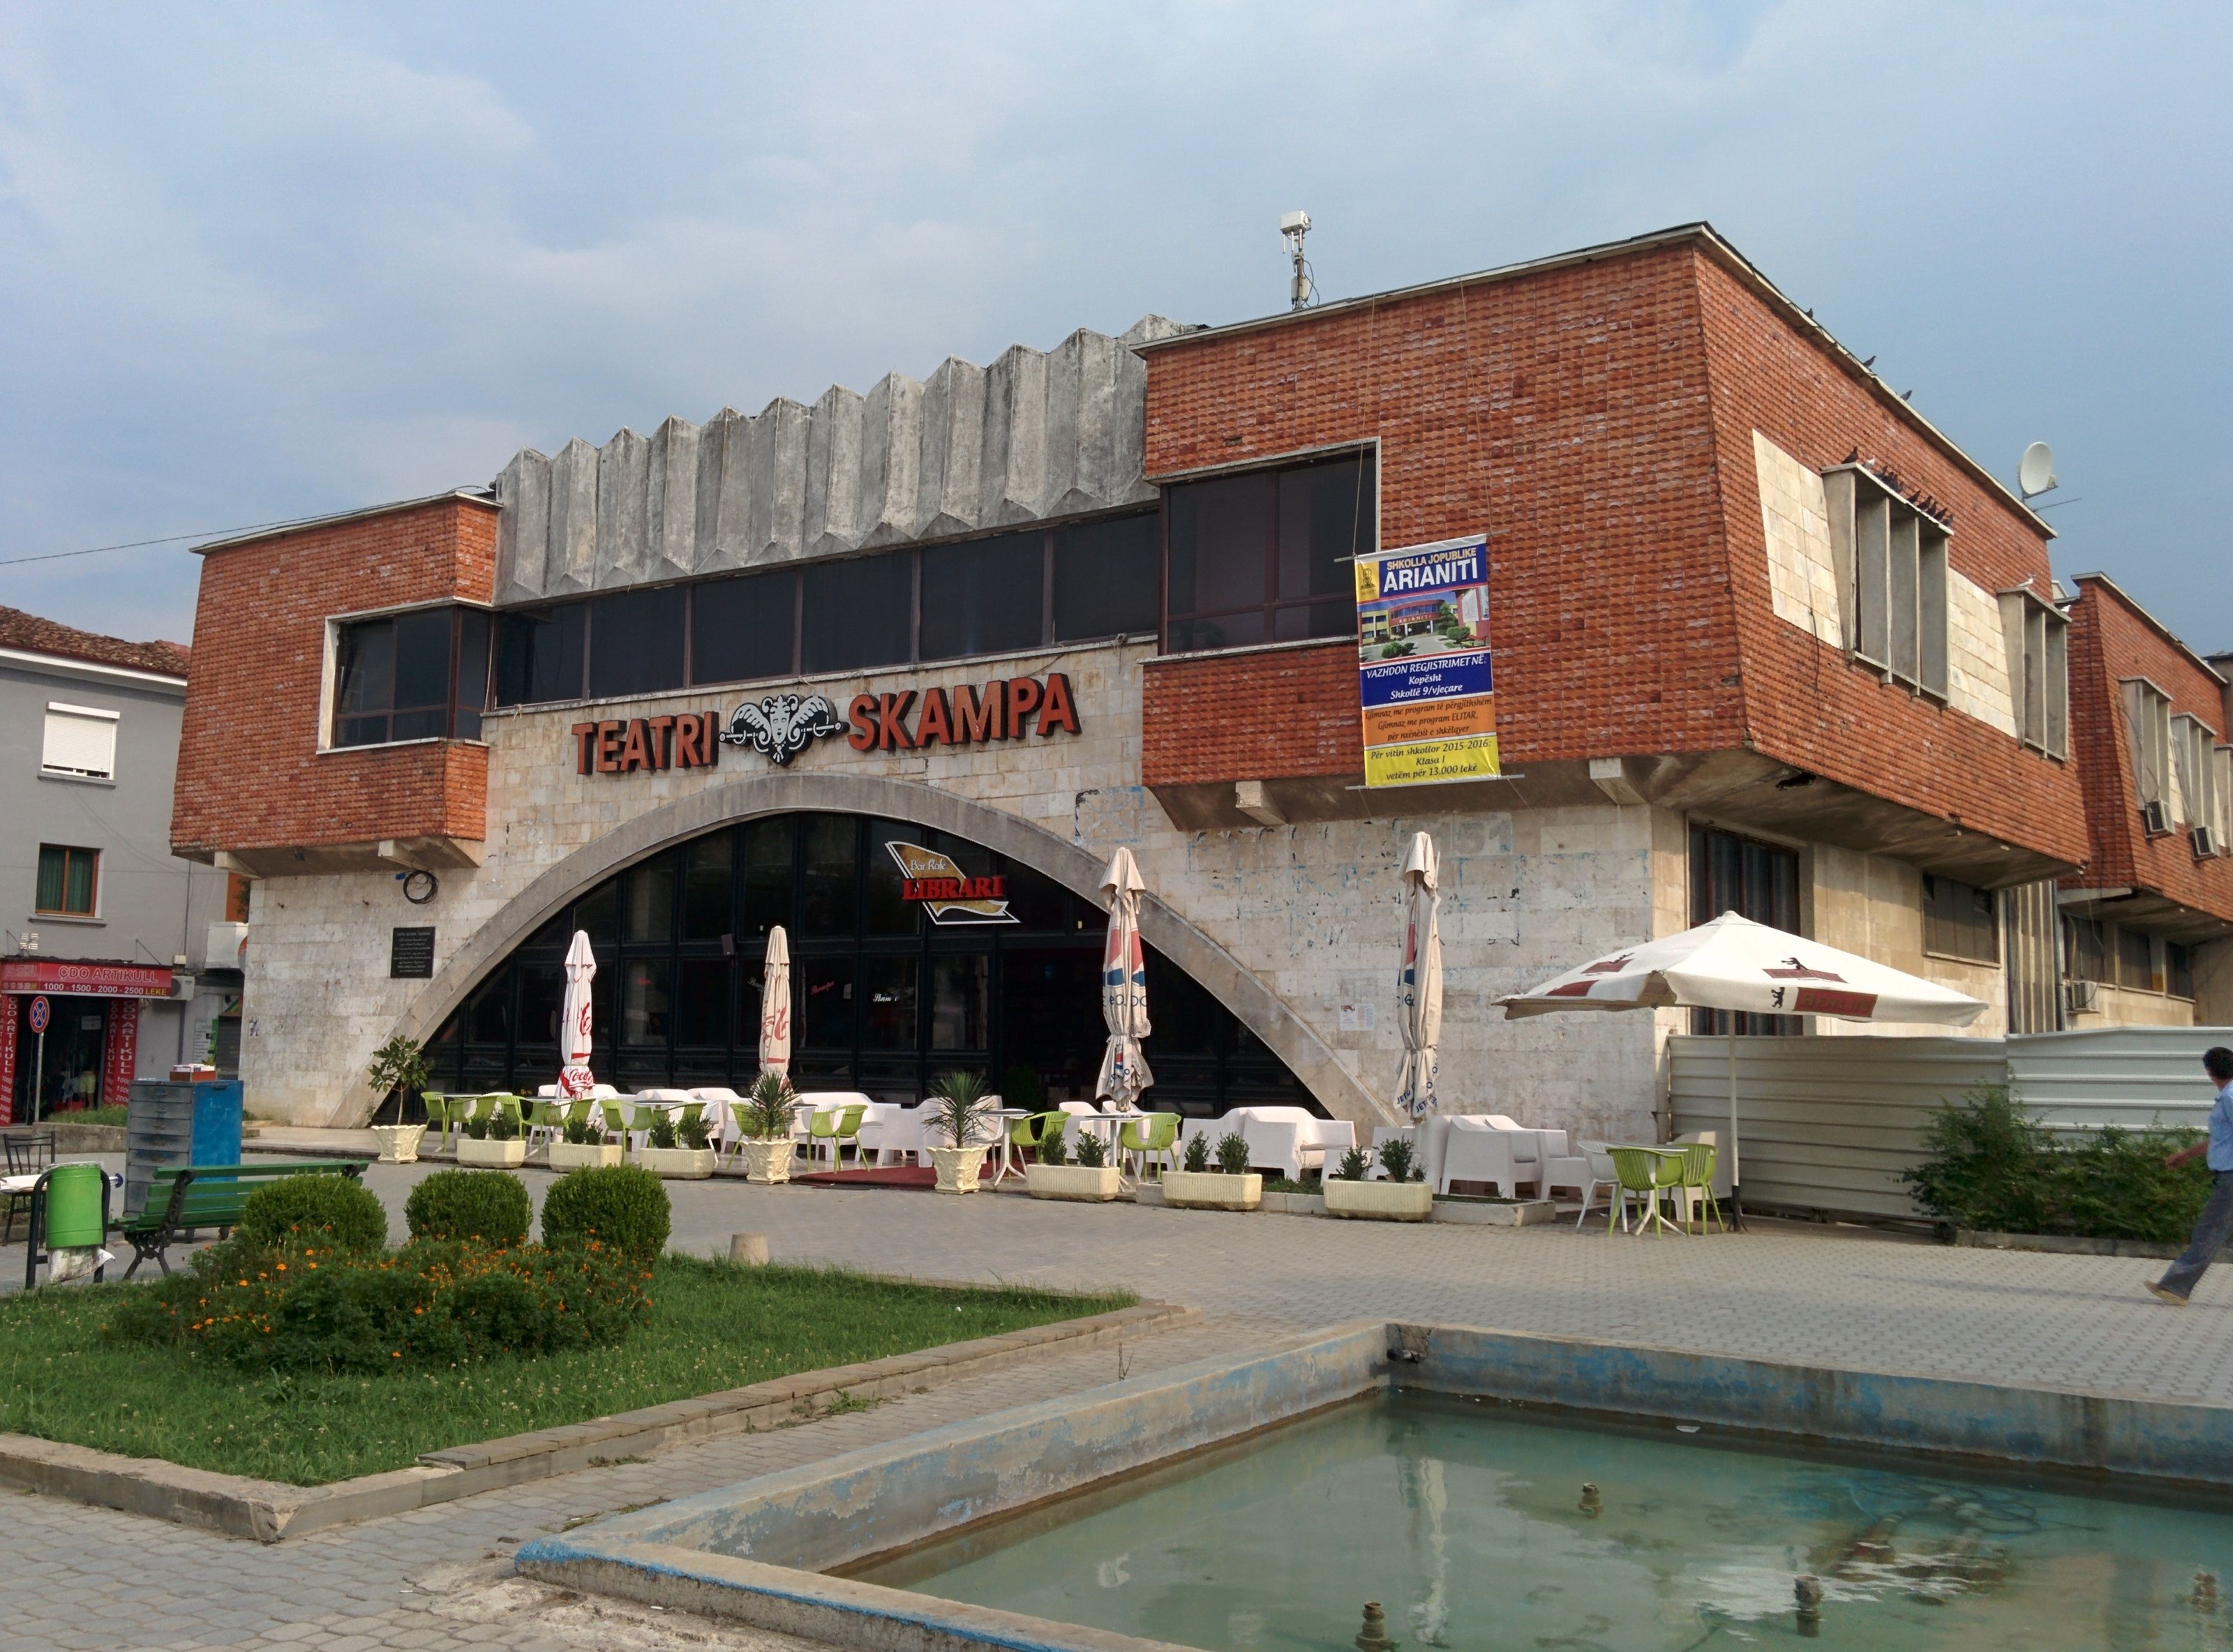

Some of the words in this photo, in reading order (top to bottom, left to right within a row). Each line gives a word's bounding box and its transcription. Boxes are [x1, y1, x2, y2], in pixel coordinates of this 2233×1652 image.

[1387, 556, 1427, 571] SHKOLLA
[1428, 547, 1477, 564] JOPUBLIKE
[1383, 557, 1478, 593] ARIANITI
[1366, 664, 1408, 679] VAZHDON
[1410, 656, 1471, 673] REGJISTRIMET
[1408, 673, 1442, 686] Kopësht
[1390, 687, 1421, 700] Shkollë
[1365, 709, 1393, 721] Gjimnaz
[1405, 705, 1435, 716] program
[571, 710, 719, 776] TEATRI
[847, 673, 1082, 753] SKAMPA
[1377, 719, 1406, 731] Gjimnaz
[1419, 715, 1450, 726] program
[1371, 751, 1384, 760] Për
[1384, 749, 1404, 758] vitin
[1407, 745, 1440, 756] shkollor
[1416, 757, 1440, 766] Klasa
[1387, 771, 1411, 780] vetëm
[1412, 769, 1427, 779] për
[1429, 765, 1458, 776] 13.000
[1460, 764, 1477, 773] lekë
[910, 859, 926, 871] Bar
[927, 858, 948, 871] Kafe
[902, 876, 1005, 901] LIBRARI
[59, 966, 90, 982] ÇDO
[92, 968, 158, 983] ARTIKULL
[44, 982, 64, 991] 1000
[71, 984, 91, 992] 1500
[98, 985, 118, 993] 2000
[124, 986, 144, 996] 2500
[145, 988, 167, 996] LEKE
[4, 1019, 16, 1074] ARTIKULL
[120, 1022, 135, 1074] ARTIKULL
